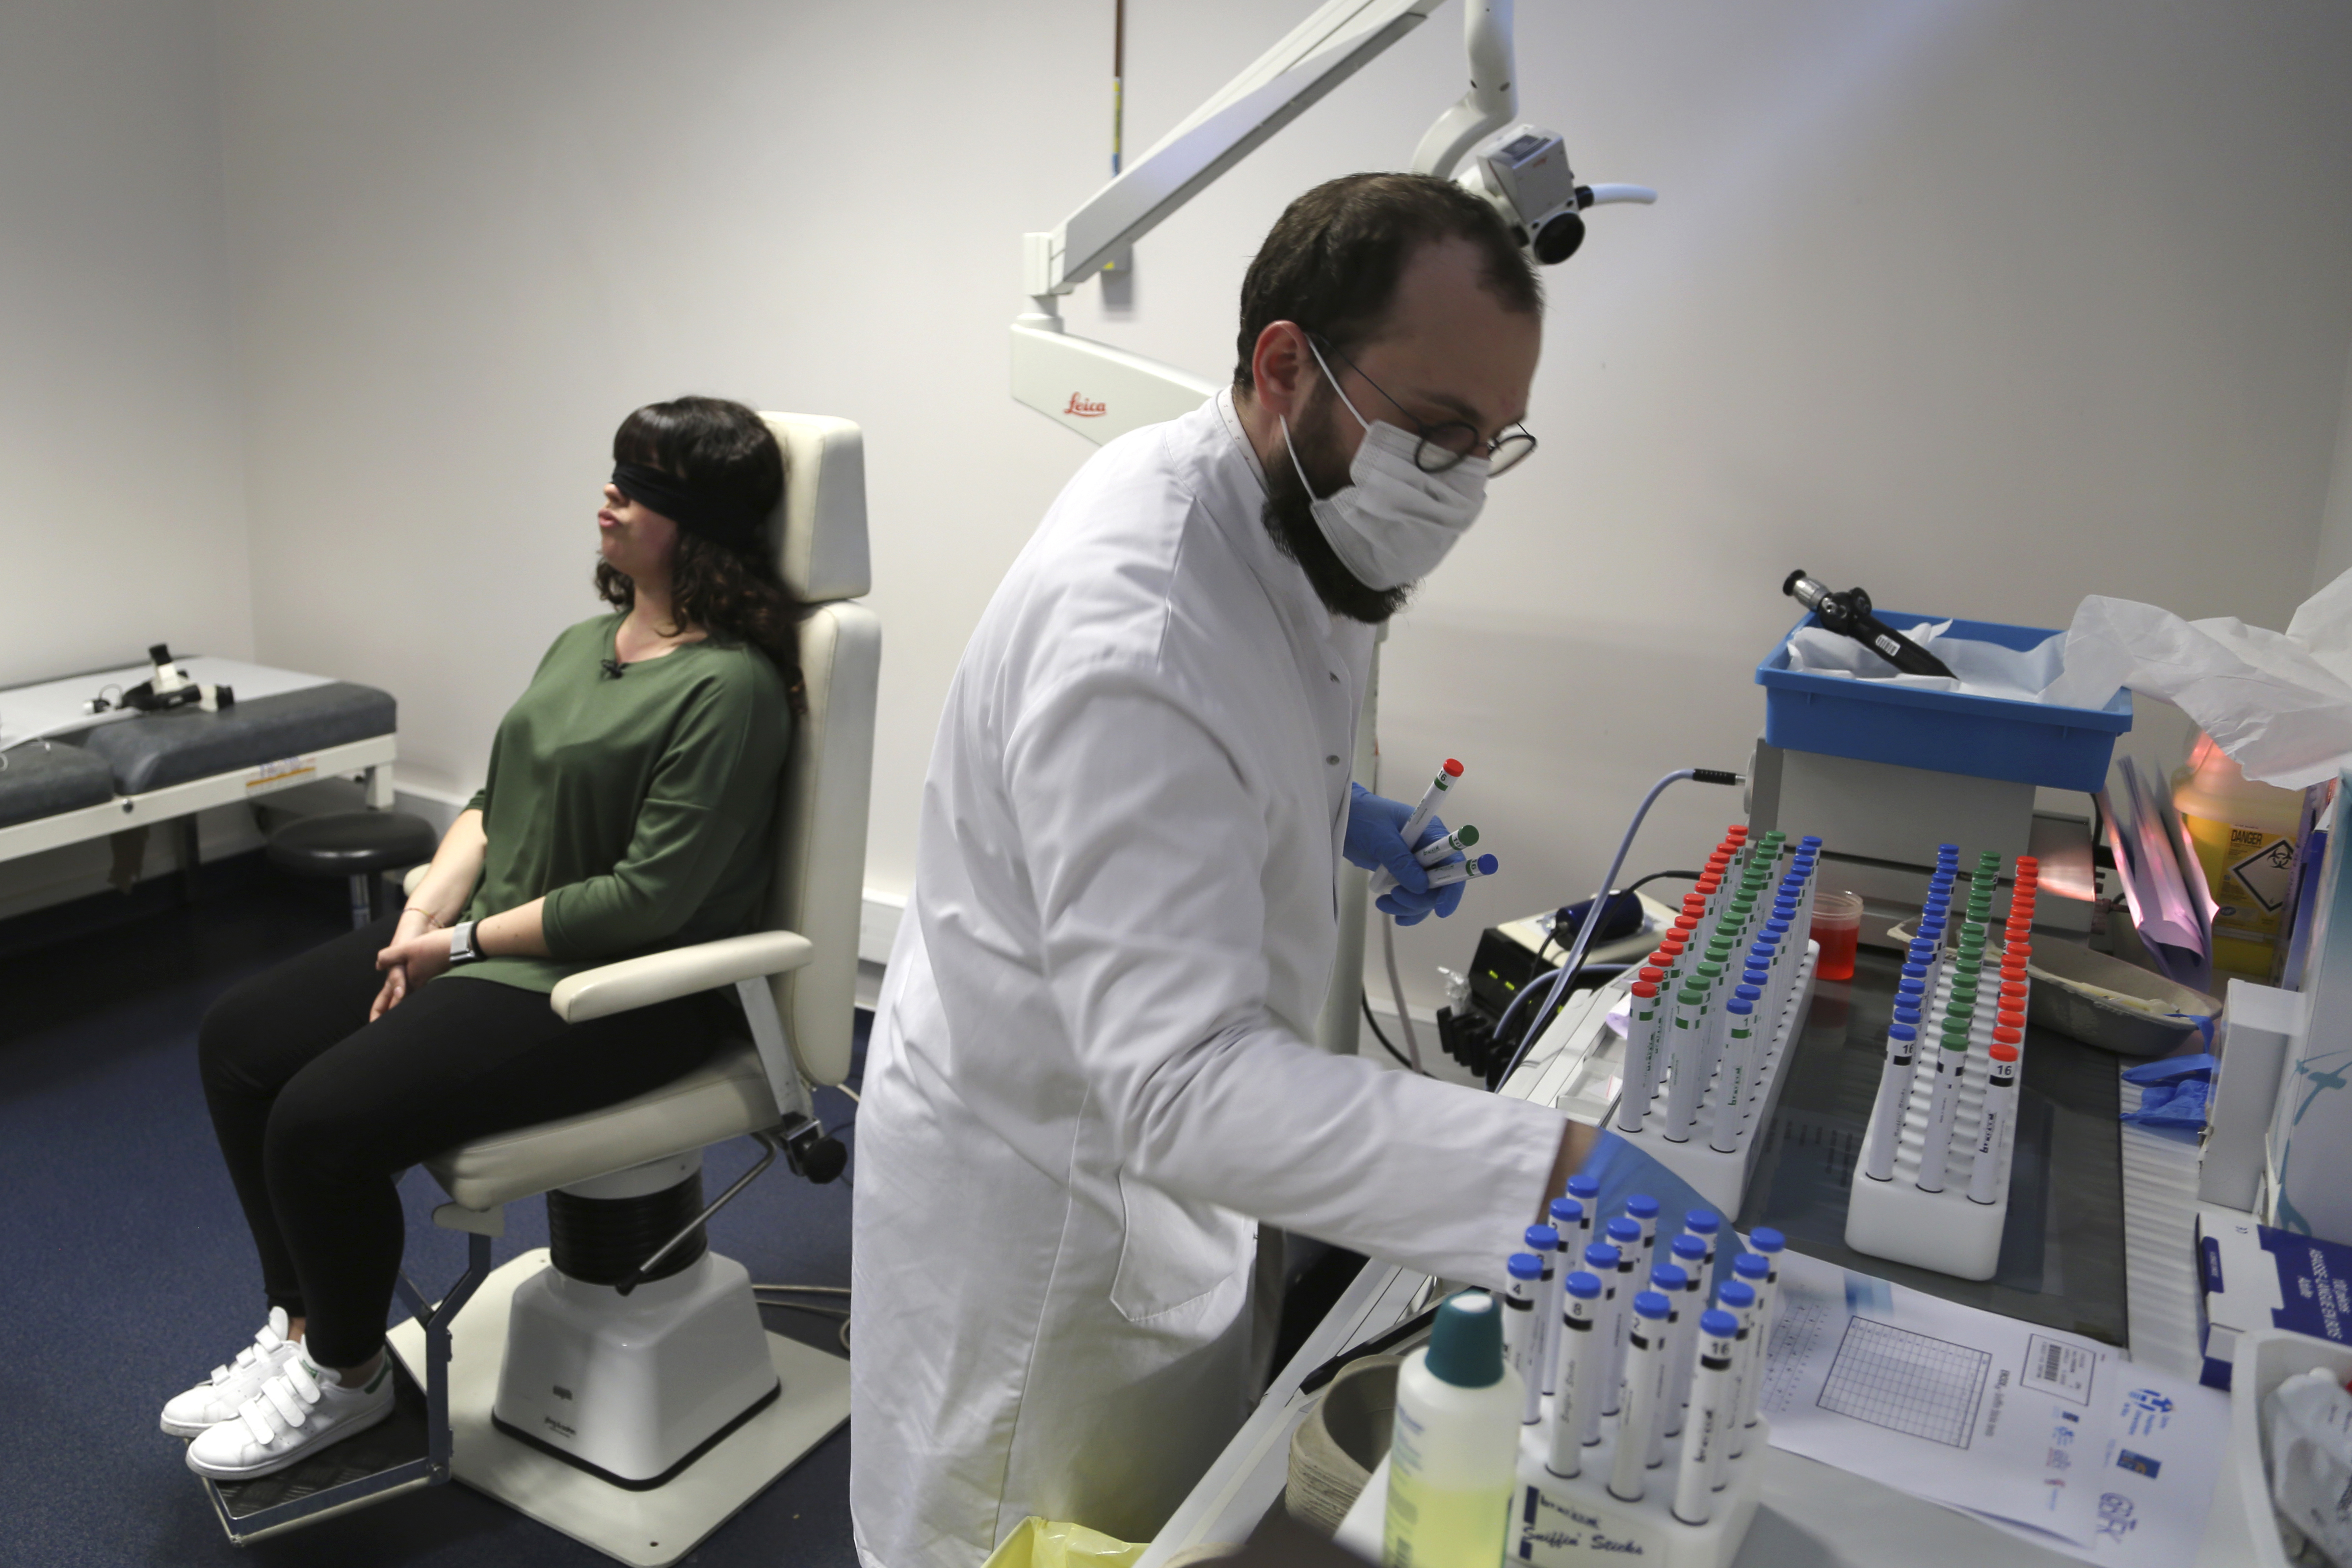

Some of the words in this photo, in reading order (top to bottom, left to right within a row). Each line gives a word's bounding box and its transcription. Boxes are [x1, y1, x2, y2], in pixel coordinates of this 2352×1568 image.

[1063, 391, 1107, 417] Leica
[1438, 770, 1447, 782] 16
[2231, 829, 2263, 845] DANGER
[1471, 858, 1478, 870] 16
[1664, 970, 1669, 980] 3
[1997, 1065, 2012, 1075] 16
[1512, 1283, 1522, 1295] 4
[1573, 1302, 1583, 1316] 8
[1711, 1342, 1730, 1356] 16
